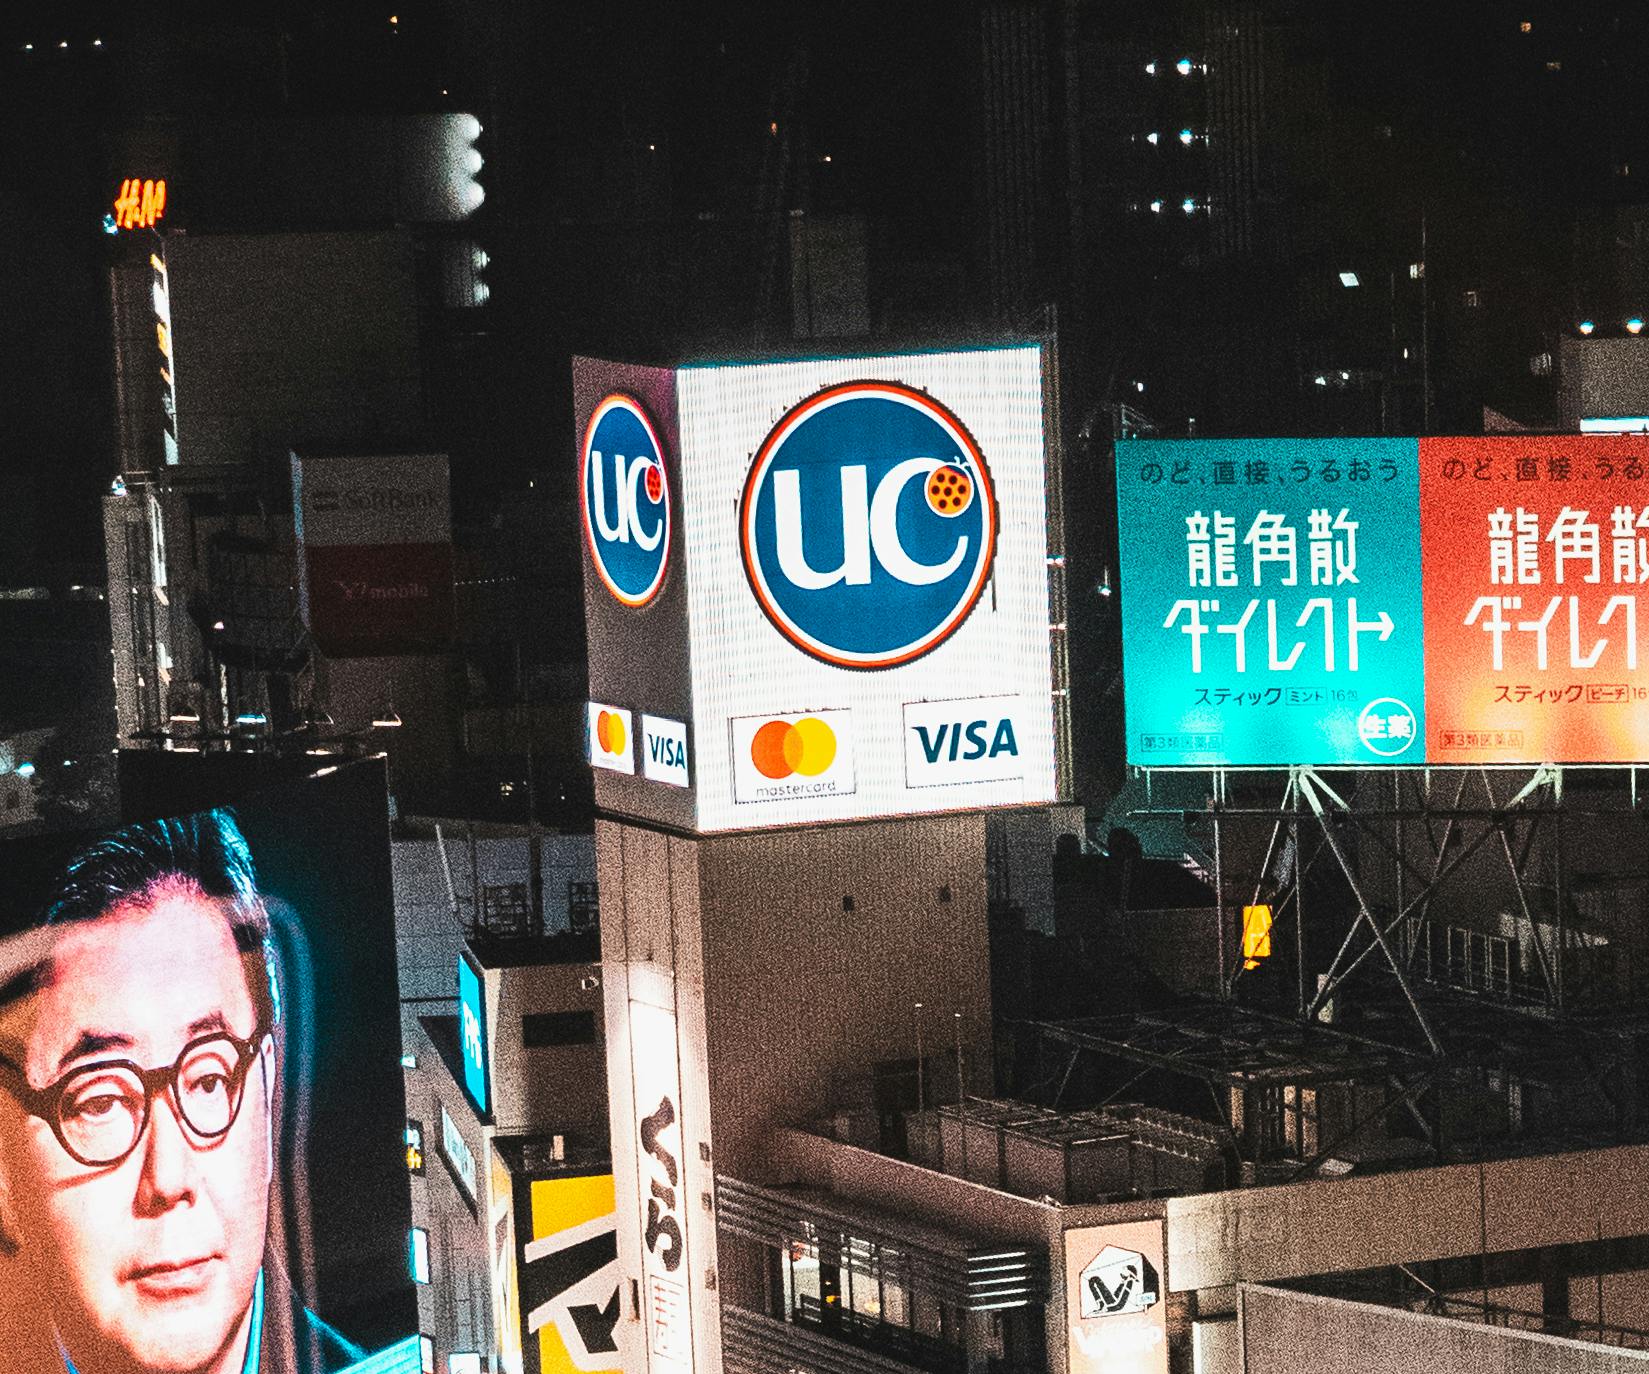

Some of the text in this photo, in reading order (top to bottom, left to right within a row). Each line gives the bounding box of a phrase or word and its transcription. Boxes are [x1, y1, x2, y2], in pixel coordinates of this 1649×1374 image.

[1139, 458, 1399, 486] のど、直接、うるおう
[1186, 508, 1360, 587] 龍角散
[1162, 598, 1396, 673] ダイレクト
[1195, 687, 1282, 707] スティック
[1494, 685, 1582, 704] スティック
[1362, 712, 1414, 740] 生薬
[647, 733, 686, 770] VISA
[911, 718, 1019, 764] VISA
[756, 780, 836, 796] mastercard
